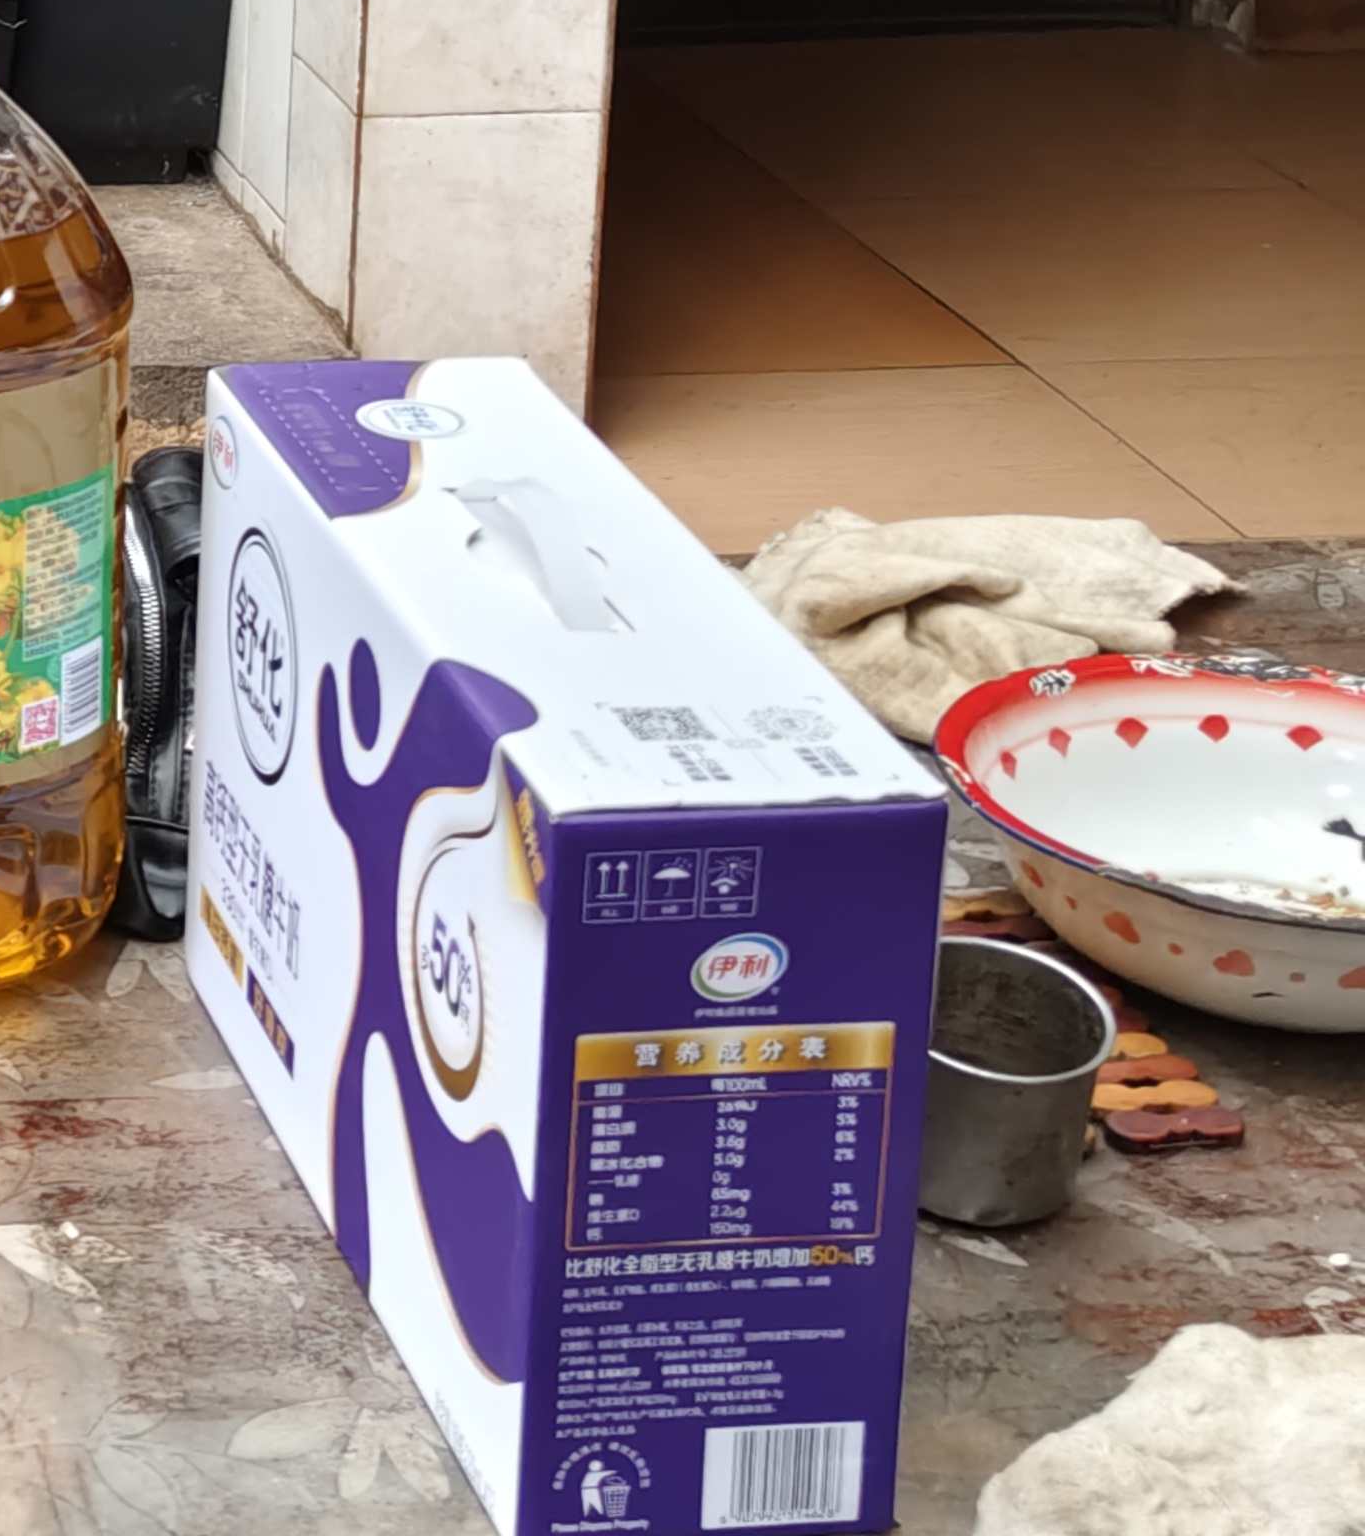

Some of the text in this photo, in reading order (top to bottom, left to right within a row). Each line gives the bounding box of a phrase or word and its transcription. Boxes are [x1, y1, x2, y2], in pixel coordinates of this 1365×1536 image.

[235, 576, 283, 720] 舒化
[707, 954, 771, 980] 伊利
[634, 1035, 828, 1068] 营养成分表
[831, 1072, 873, 1088] NRV%
